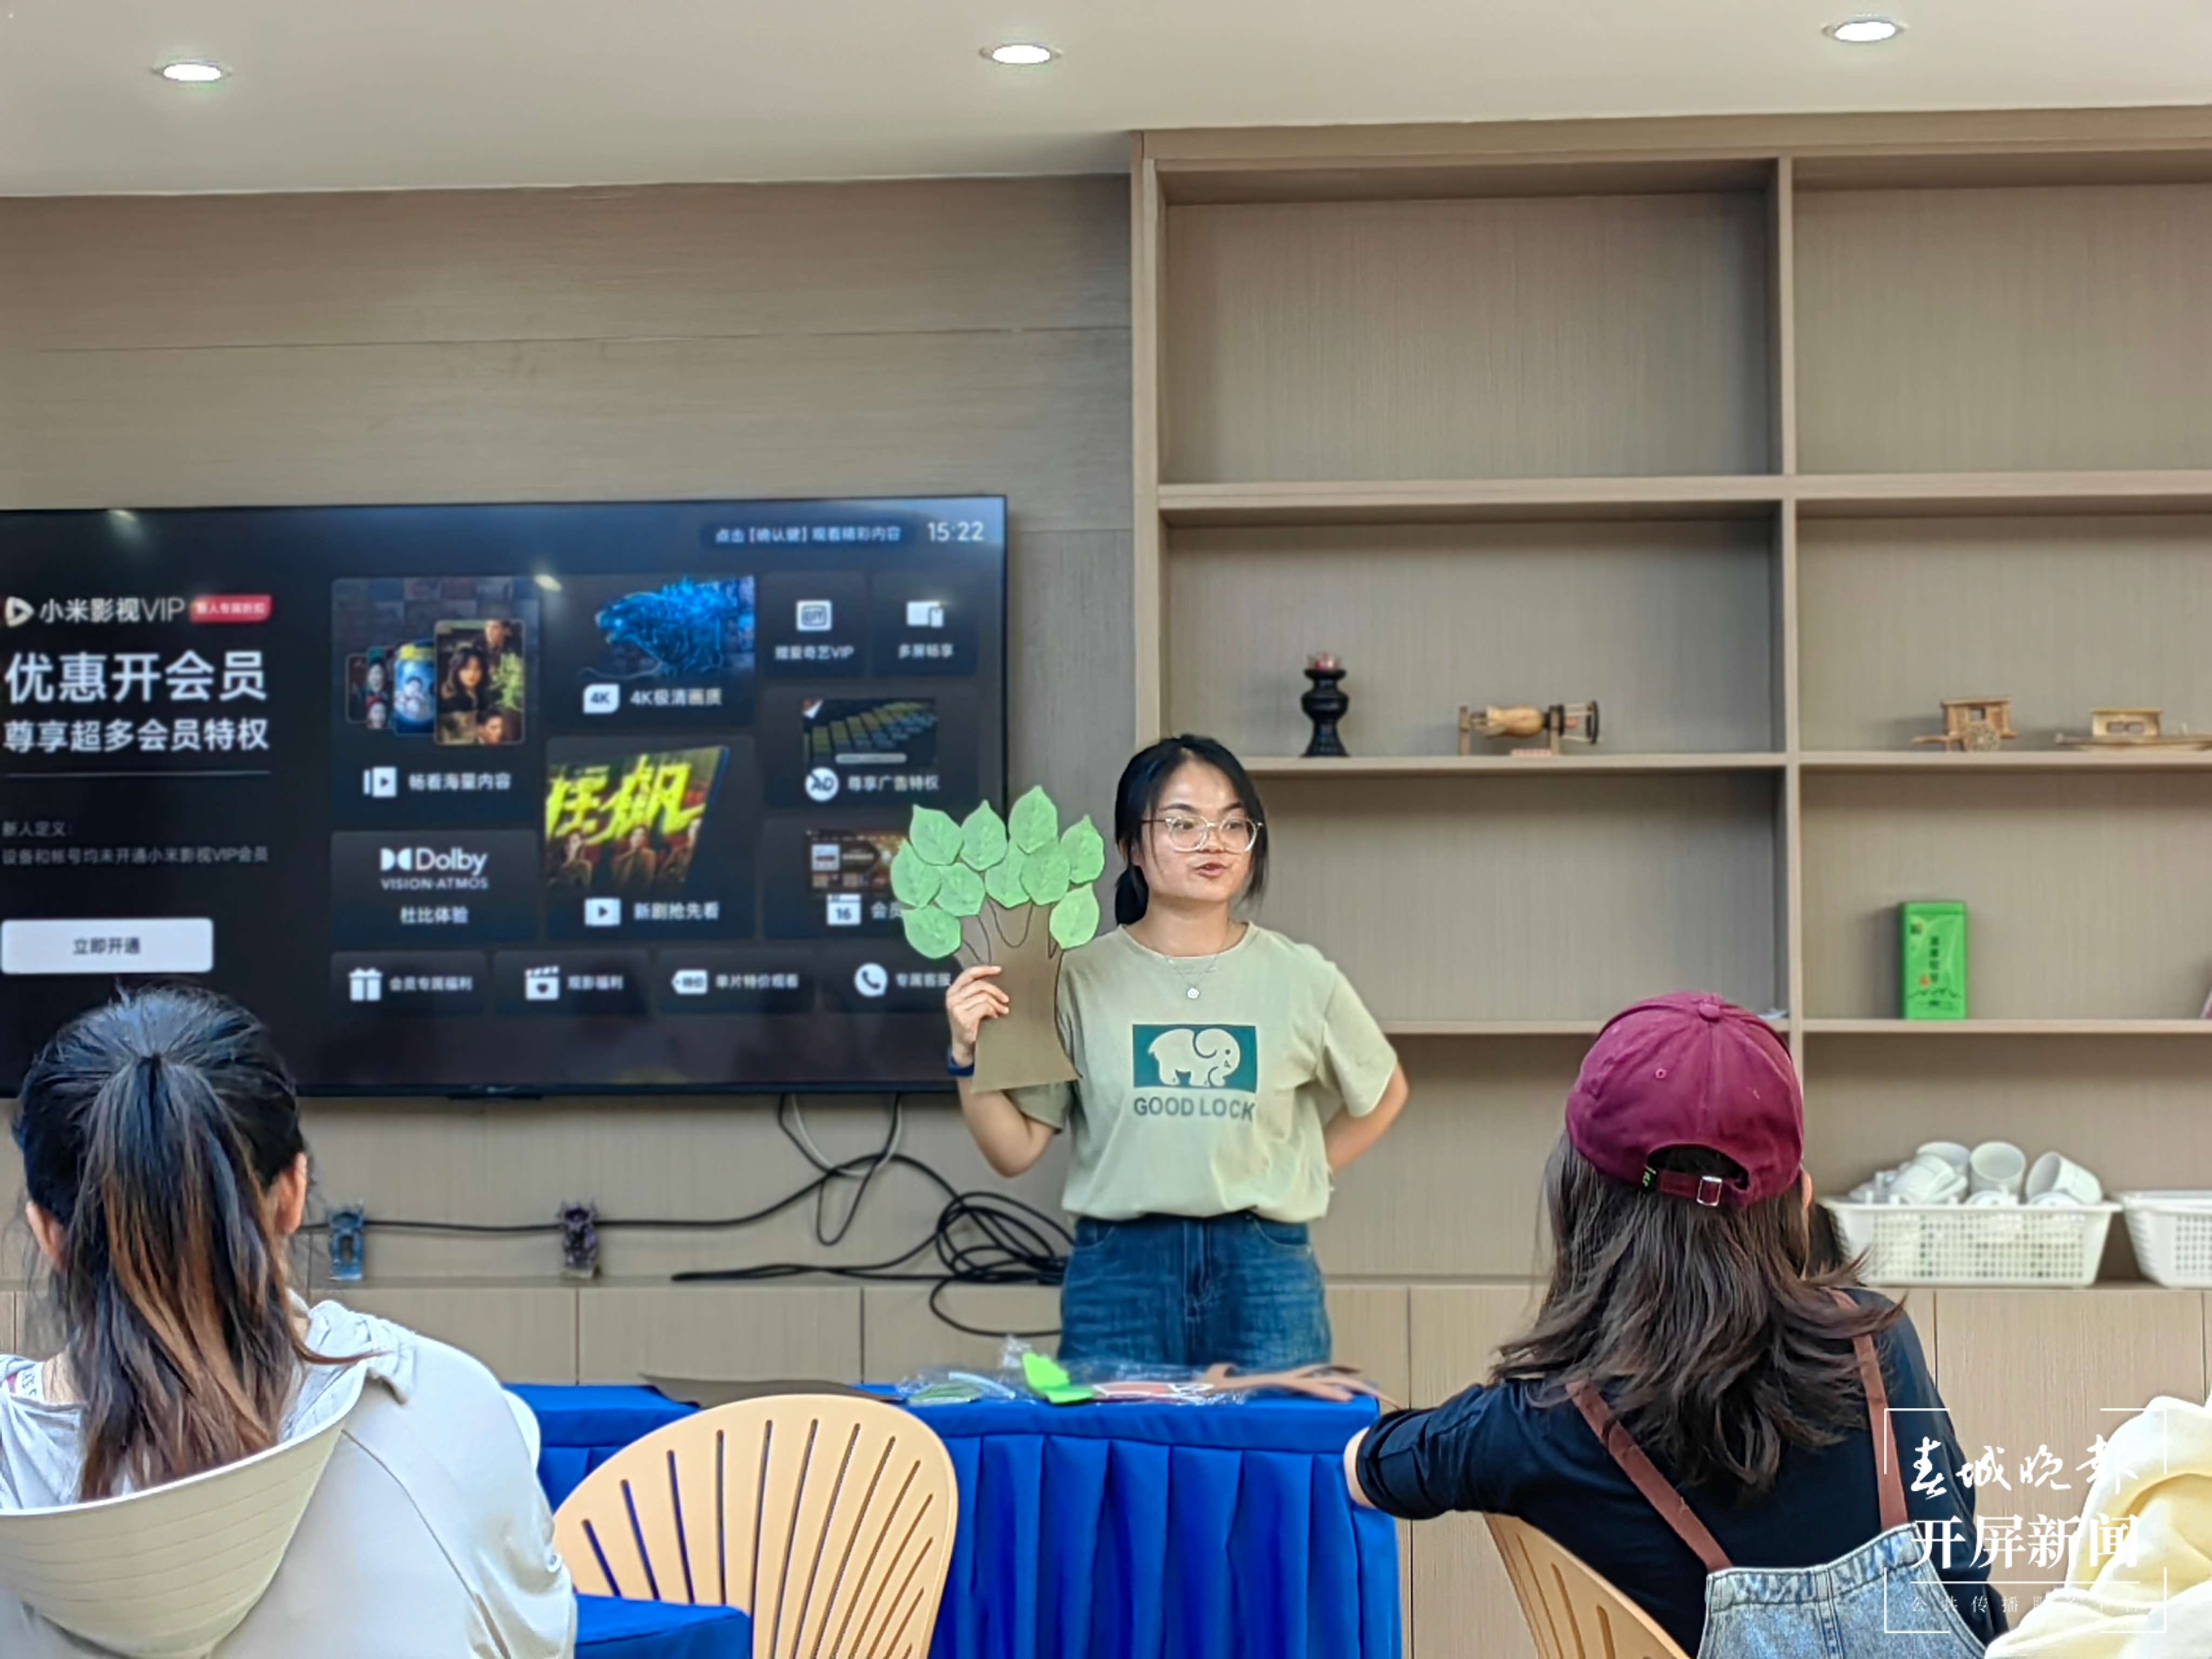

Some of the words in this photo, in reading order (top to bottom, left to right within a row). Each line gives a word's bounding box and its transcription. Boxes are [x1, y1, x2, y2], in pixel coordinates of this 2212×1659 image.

[928, 522, 985, 542] 15:22
[39, 597, 185, 623] 小米影视VIP
[4, 650, 267, 703] 优惠开会员
[590, 691, 610, 705] 4K
[630, 688, 723, 706] 4K极清画质
[3, 718, 269, 753] 尊享超多会员特权
[848, 775, 939, 792] 尊享广告特权
[415, 846, 488, 876] Dolby
[401, 906, 469, 925] 杜比体验
[634, 901, 719, 920] 新剧抢先看
[836, 908, 852, 920] 16
[73, 938, 140, 955] 立即开通
[1134, 1096, 1194, 1116] GOOD
[1199, 1097, 1256, 1122] LOCK
